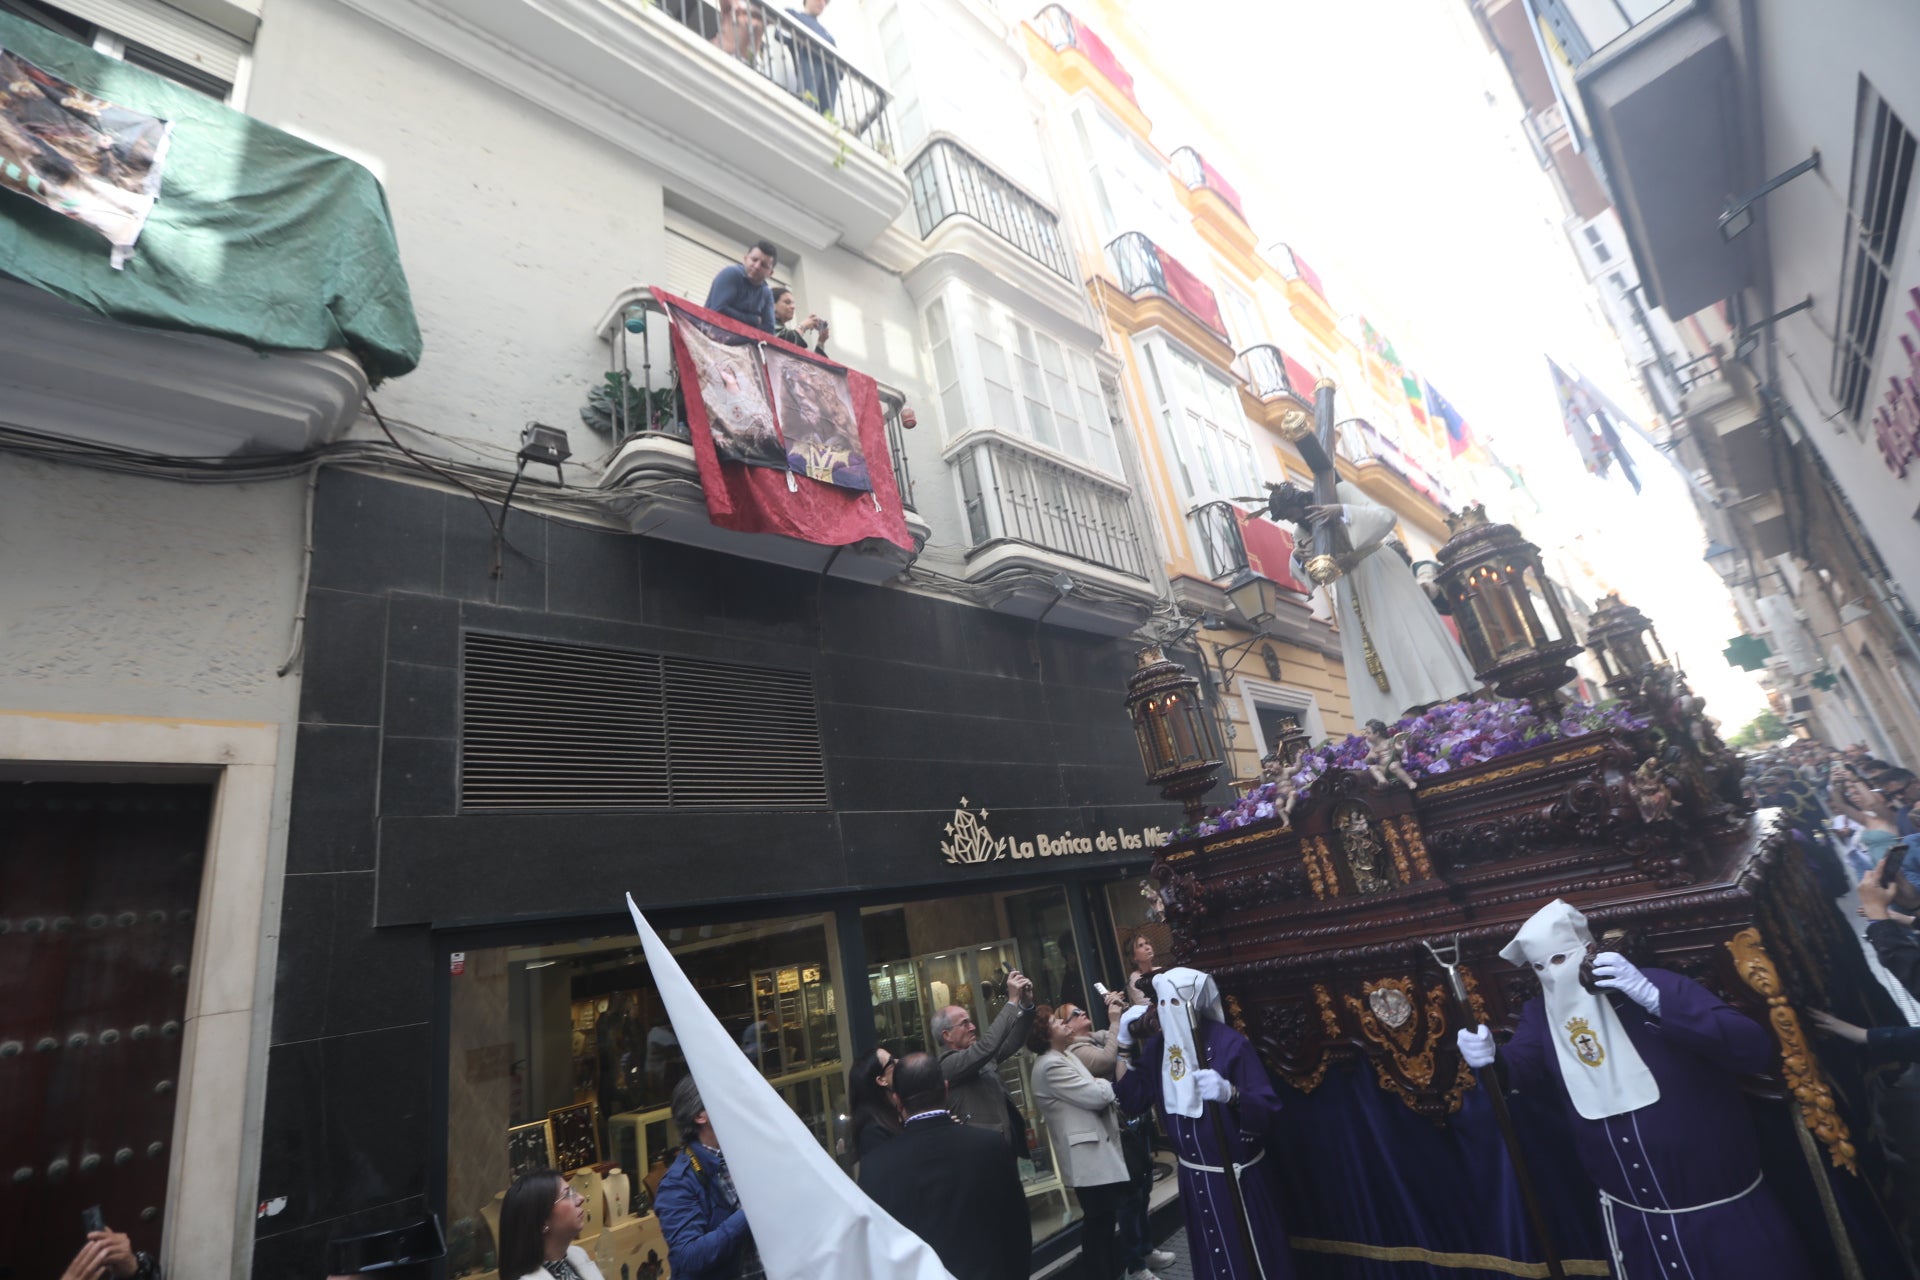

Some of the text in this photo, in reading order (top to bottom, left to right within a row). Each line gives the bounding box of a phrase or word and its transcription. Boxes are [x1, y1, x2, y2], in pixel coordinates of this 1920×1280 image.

[1009, 836, 1034, 859] La
[1037, 831, 1093, 857] Botica
[1095, 831, 1118, 852] de
[1118, 827, 1142, 850] los
